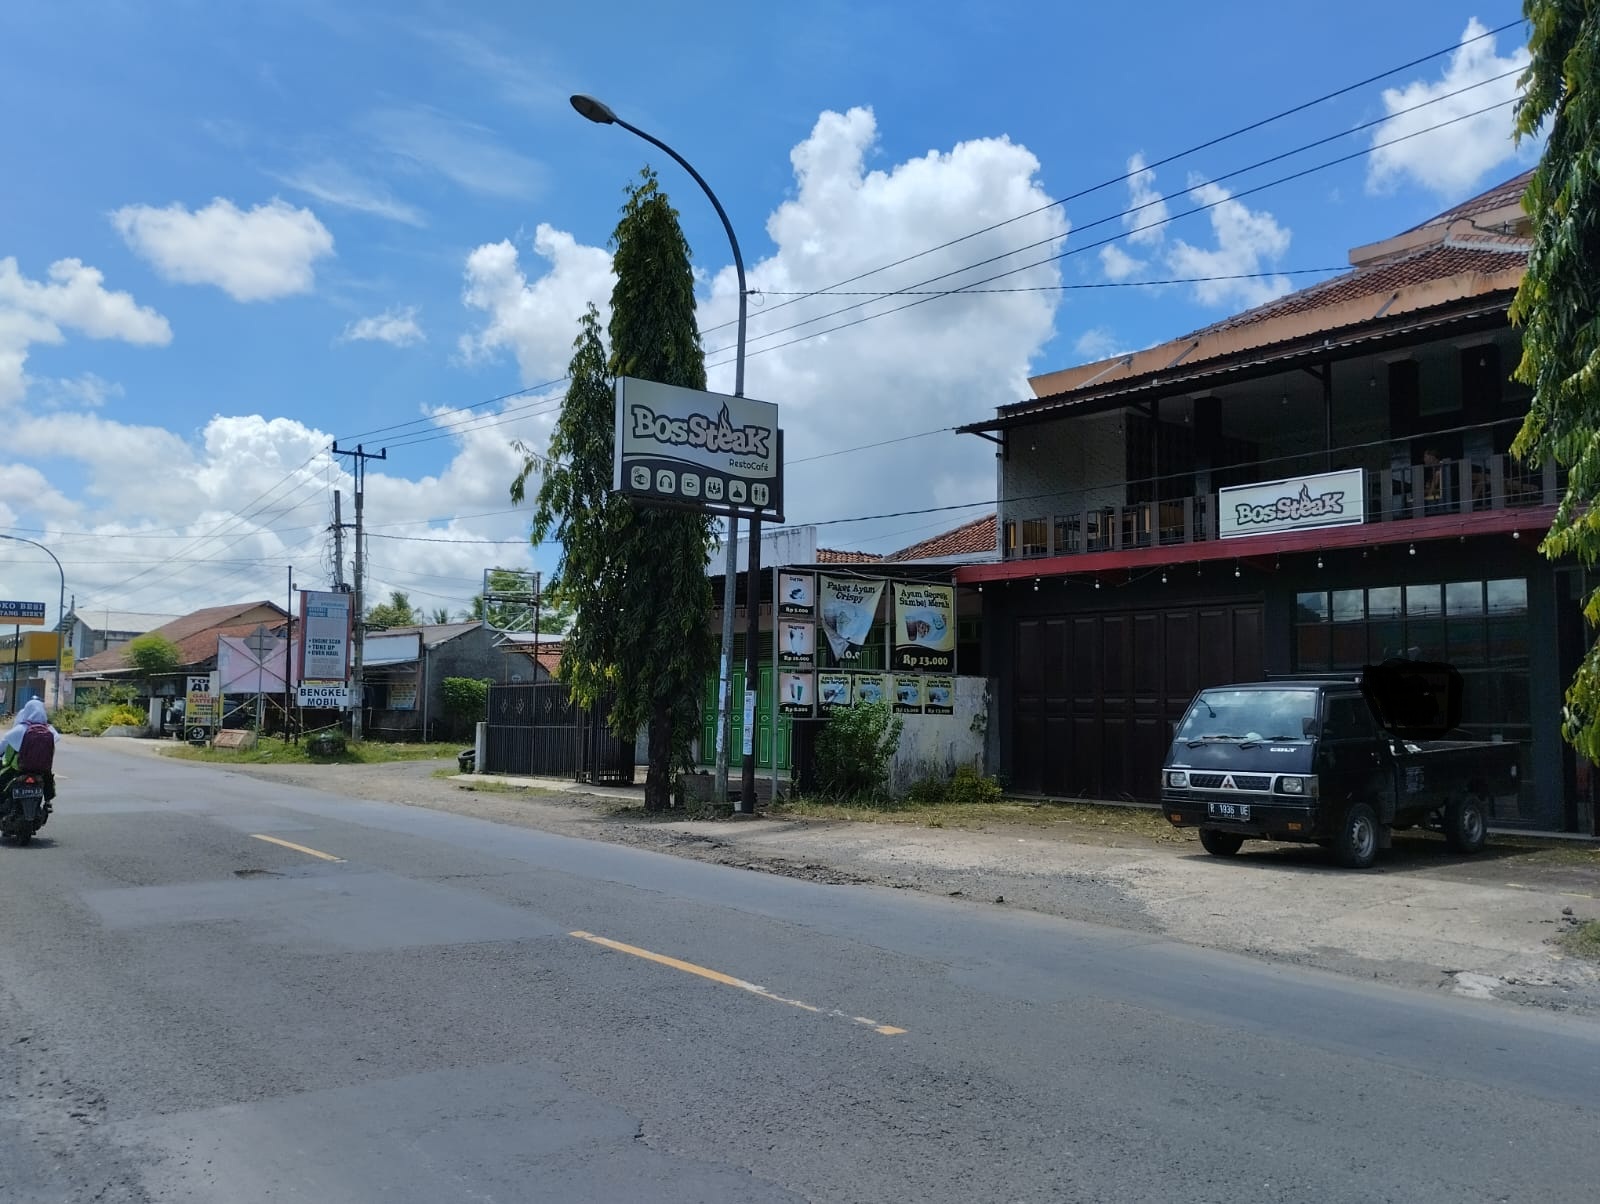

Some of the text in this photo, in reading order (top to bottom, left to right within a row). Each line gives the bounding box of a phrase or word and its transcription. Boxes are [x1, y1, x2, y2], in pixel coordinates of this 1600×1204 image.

[728, 459, 769, 472] RestoCafé
[827, 581, 876, 595] Paket Ayam
[835, 592, 864, 604] Crispy
[901, 589, 949, 601] Ayam Geprek
[903, 654, 948, 667] Rp 13.000
[300, 688, 348, 697] BENGKEL
[307, 698, 340, 706] MOBIL
